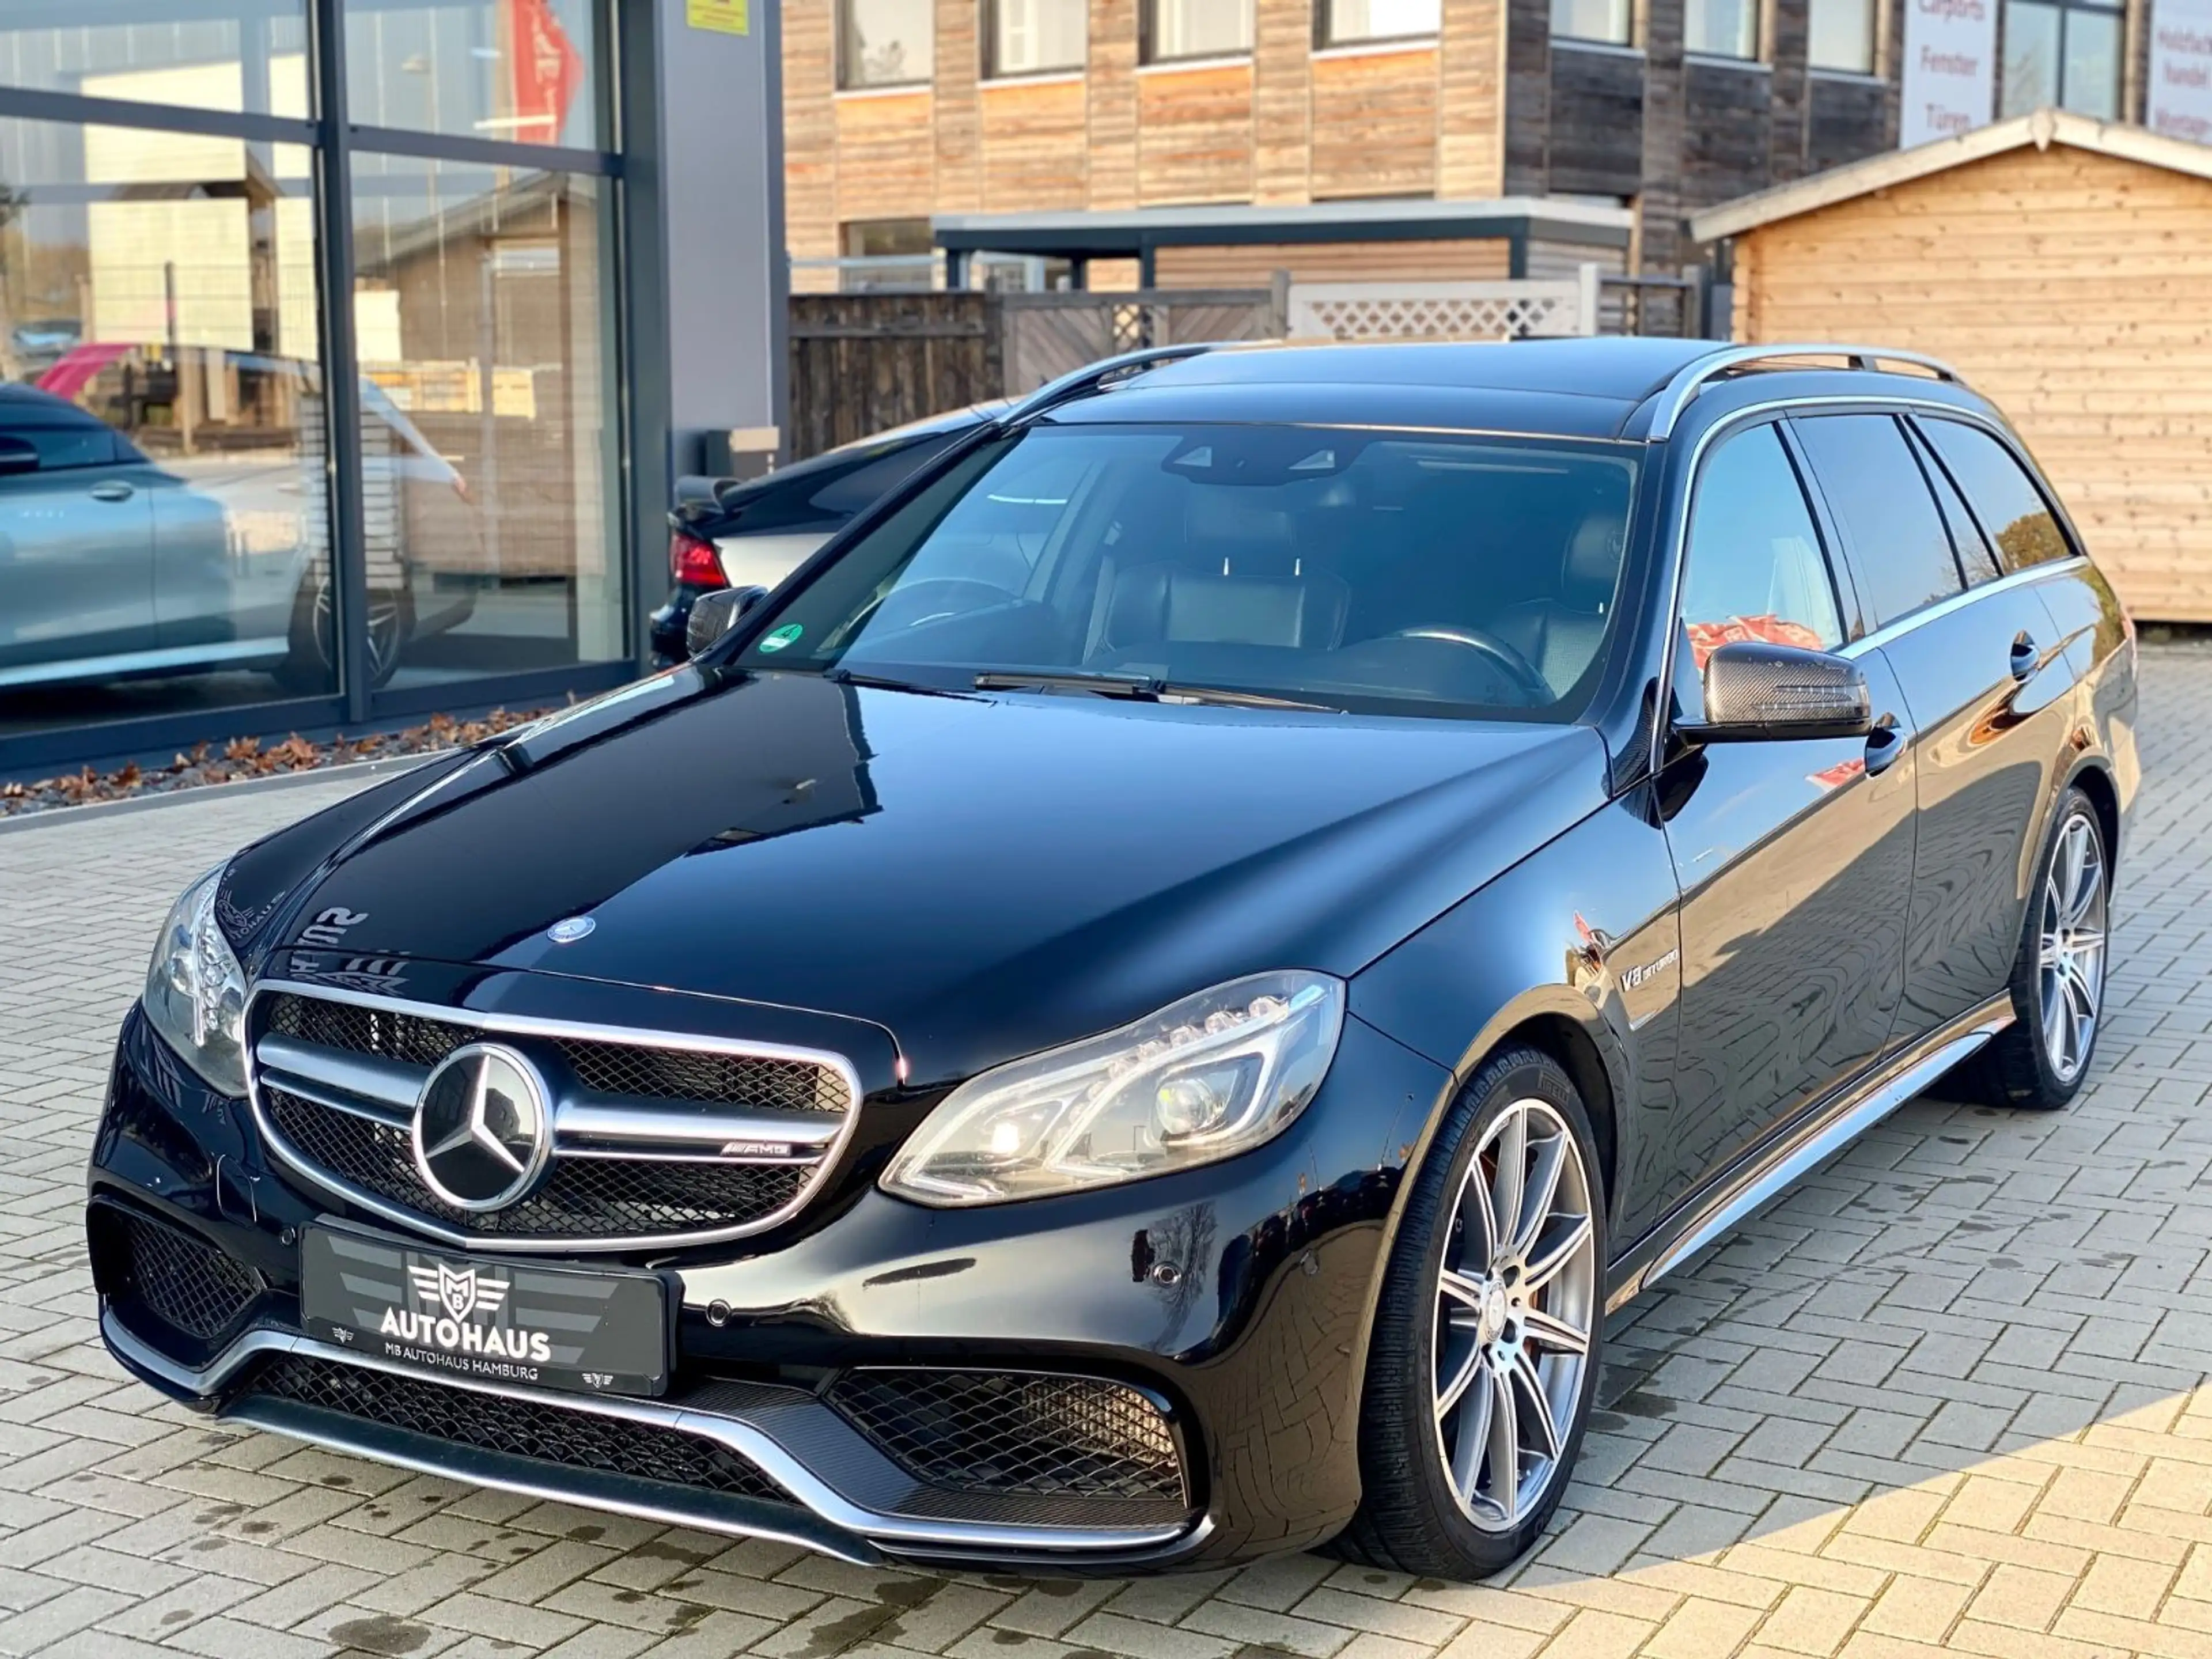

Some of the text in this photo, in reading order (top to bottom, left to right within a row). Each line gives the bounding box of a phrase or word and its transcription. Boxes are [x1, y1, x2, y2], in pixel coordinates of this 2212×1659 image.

[1621, 965, 1641, 991] V8
[380, 1306, 551, 1362] AUTOHAUS
[385, 1342, 539, 1380] MB AUTOHAUS HAMBURG
